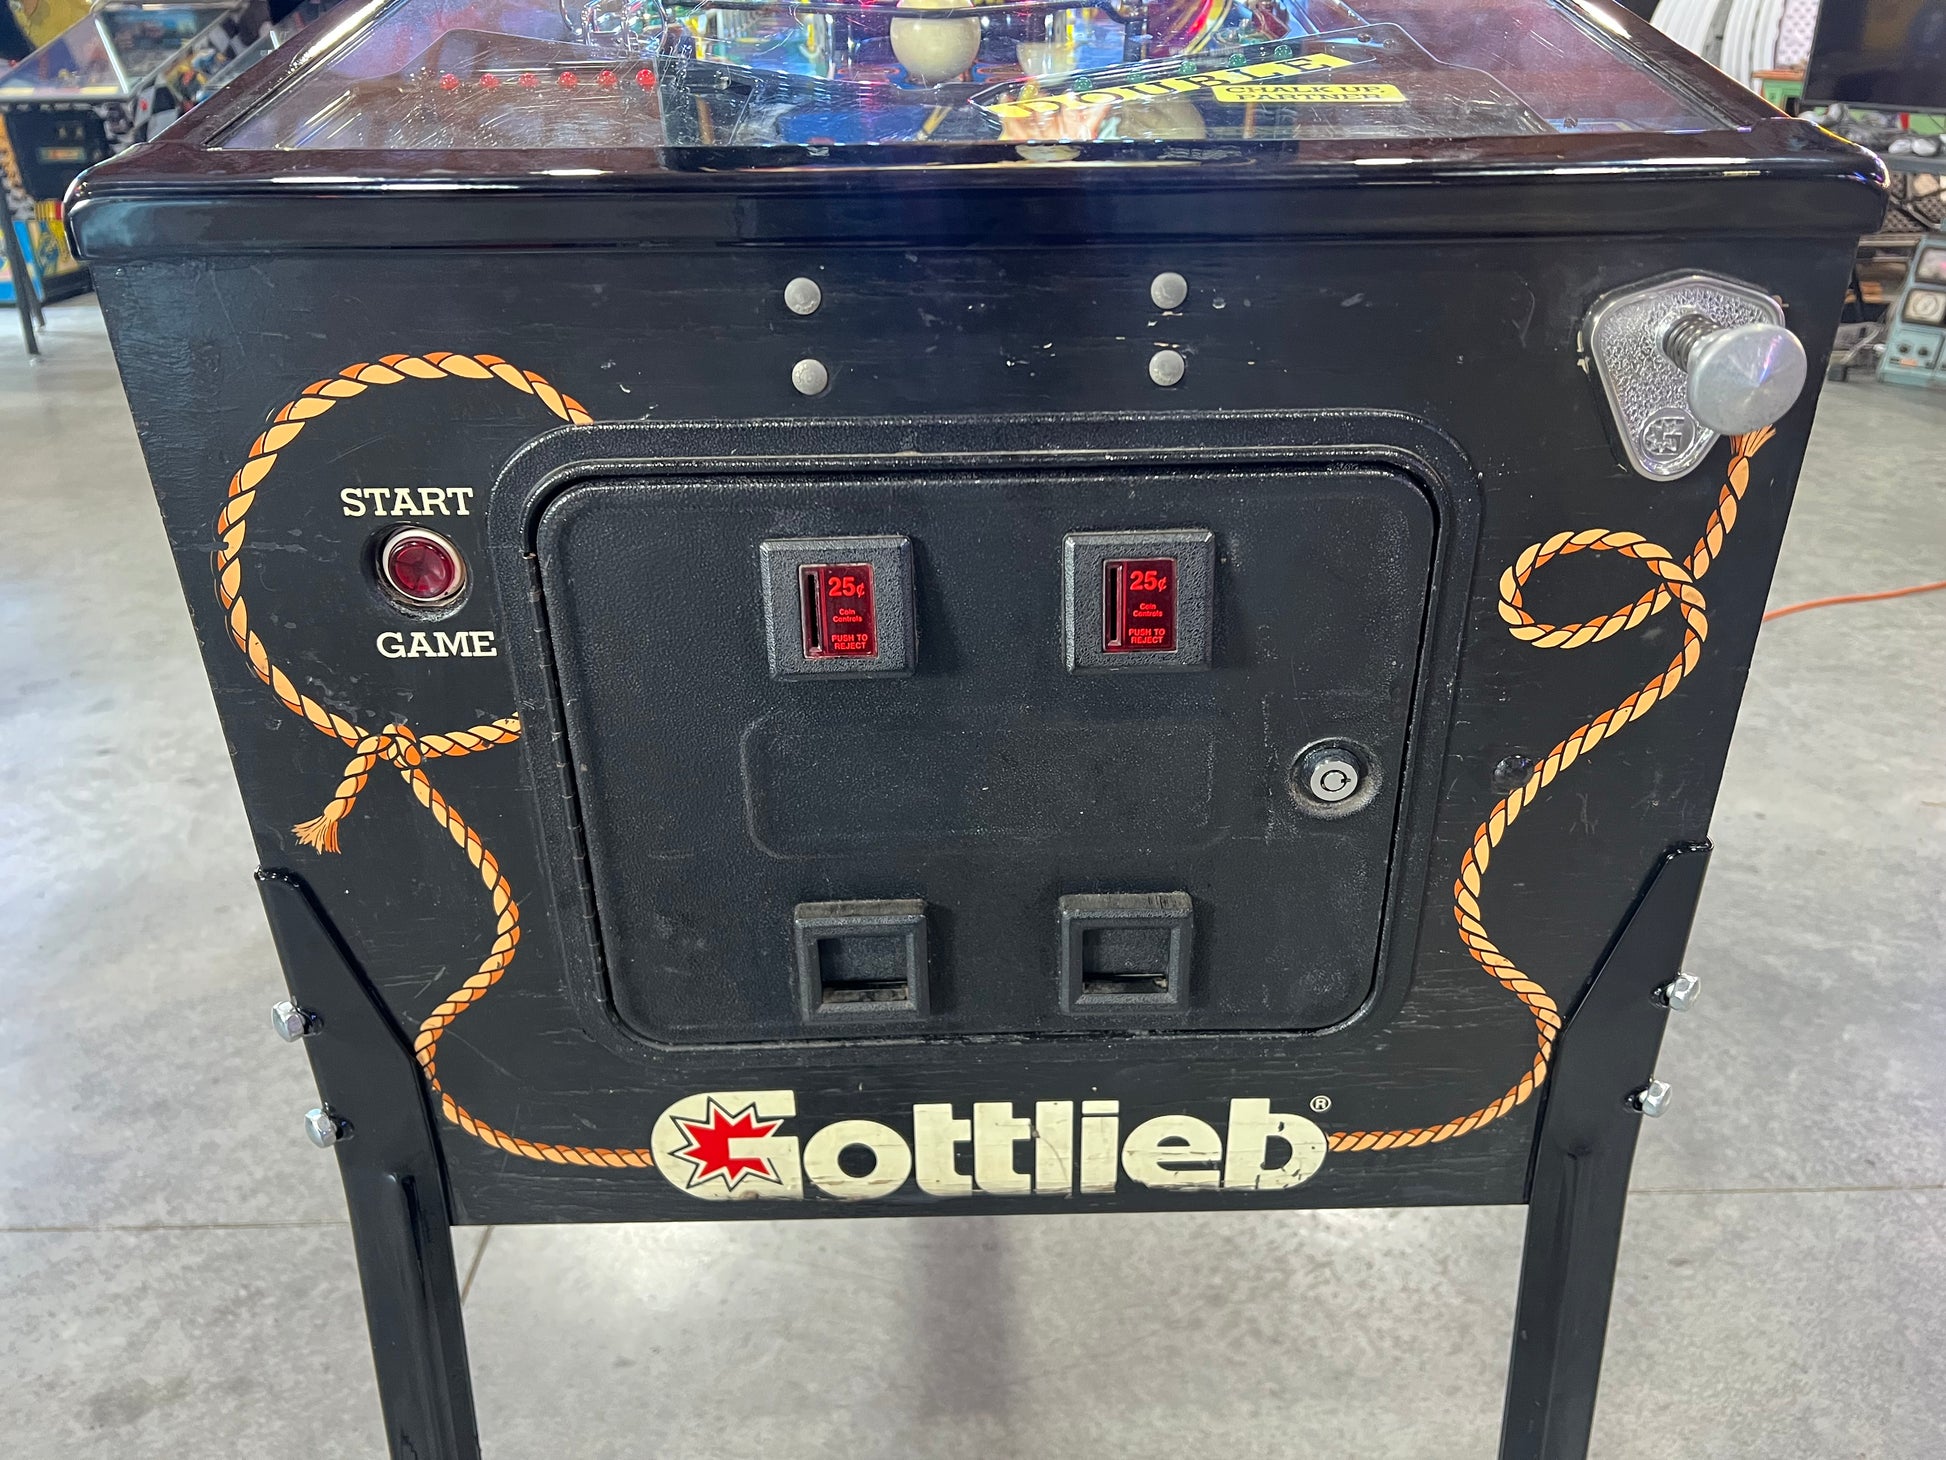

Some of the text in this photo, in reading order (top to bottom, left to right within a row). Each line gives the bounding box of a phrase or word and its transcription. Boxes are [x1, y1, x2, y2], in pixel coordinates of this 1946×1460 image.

[1007, 57, 1333, 116] DOUBLE
[340, 487, 474, 517] START
[828, 576, 865, 598] 25¢
[1130, 570, 1167, 592] 25¢
[831, 633, 868, 642] PUSH TO
[1128, 628, 1152, 636] PUSH
[1131, 636, 1164, 644] REJECT
[376, 631, 498, 658] GAME
[834, 642, 867, 650] REJECT
[651, 1090, 1329, 1201] Gottlieb
